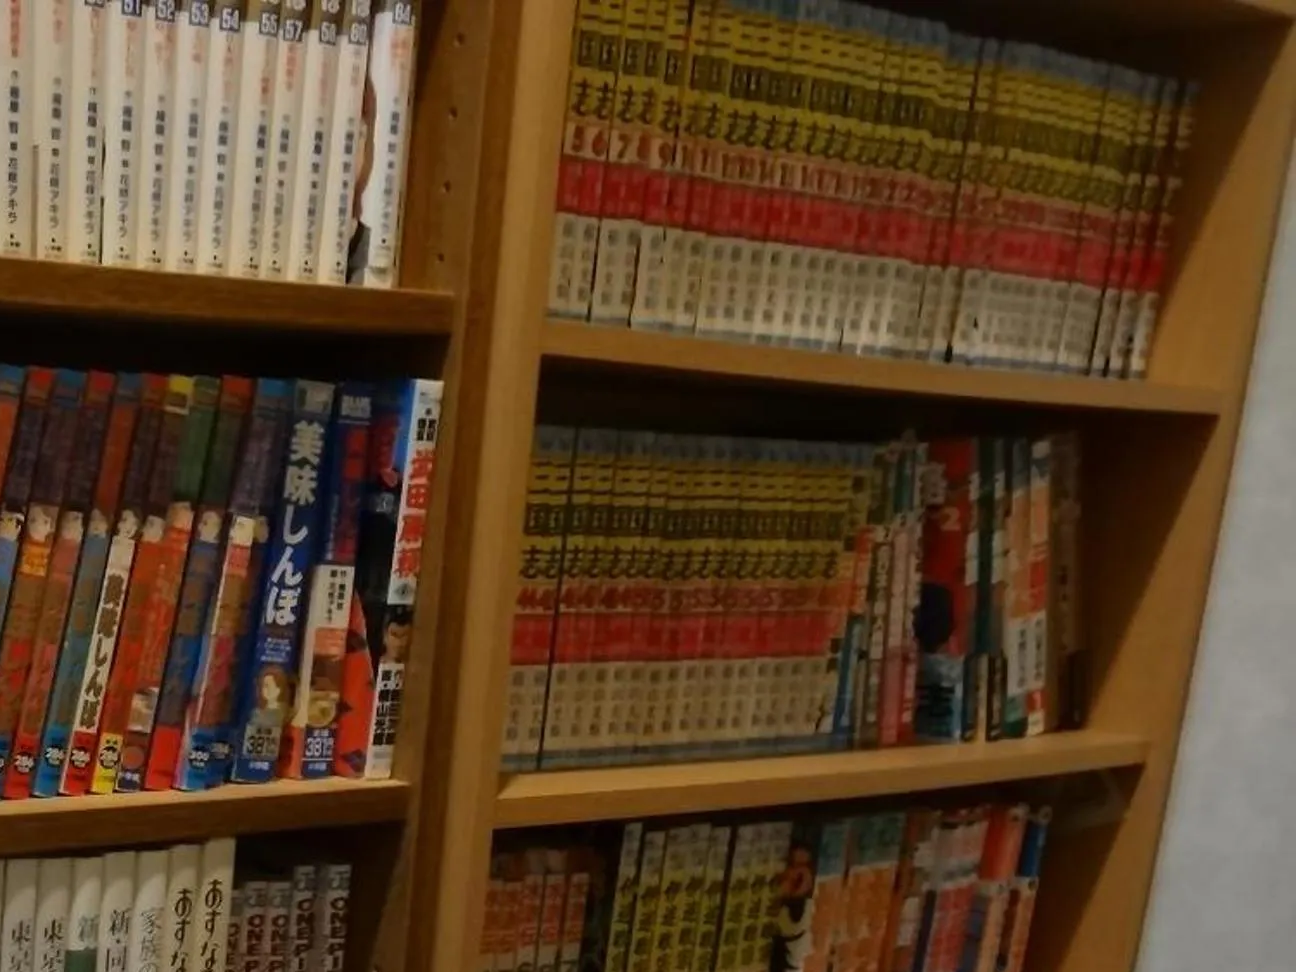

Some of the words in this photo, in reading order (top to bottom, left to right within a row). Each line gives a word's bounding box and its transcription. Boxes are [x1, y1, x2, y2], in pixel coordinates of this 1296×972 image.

[263, 419, 326, 626] 美味しんぼ
